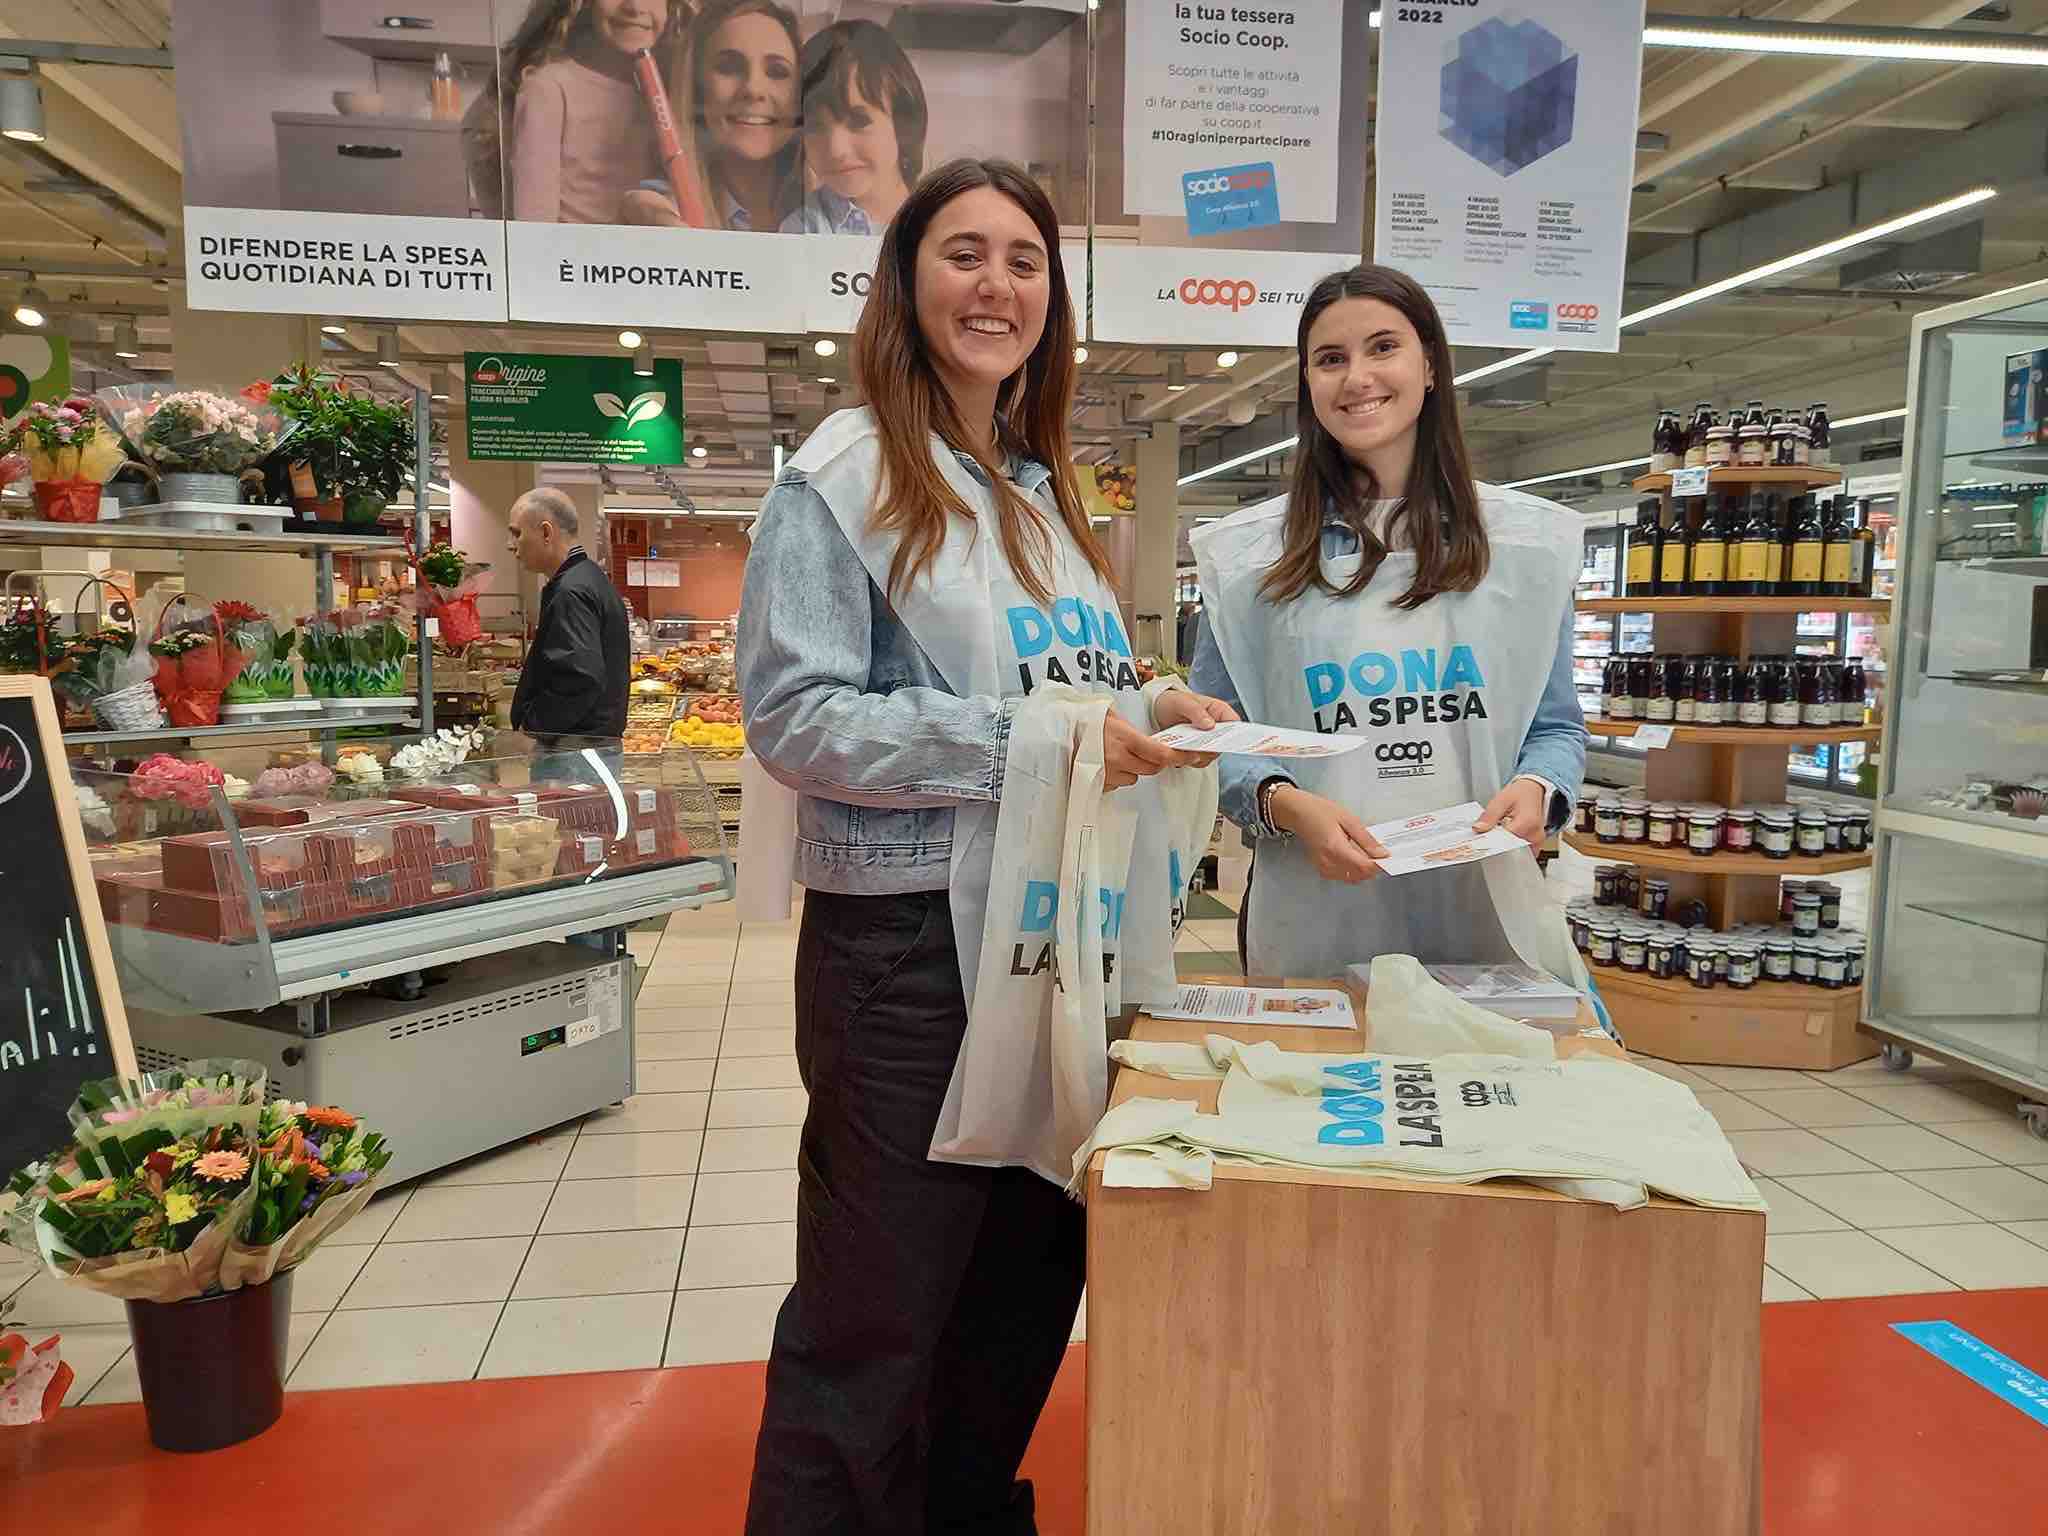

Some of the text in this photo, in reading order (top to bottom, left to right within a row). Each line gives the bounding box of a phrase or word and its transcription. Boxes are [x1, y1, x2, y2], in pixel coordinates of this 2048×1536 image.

[1175, 3, 1295, 25] la tua tessera
[1398, 8, 1443, 24] 2022
[1180, 27, 1289, 51] Socio Coop.
[1168, 65, 1208, 79] Scopri
[1211, 67, 1240, 80] tutte
[199, 236, 488, 267] DIFENDERE LA SPESA
[200, 261, 492, 291] QUOTIDIANA DI TUTTI
[560, 259, 750, 291] È IMPORTANTE.
[1158, 289, 1176, 301] LA
[1179, 278, 1257, 313] coop
[1258, 292, 1282, 304] SEI
[1304, 645, 1486, 709] DONA
[1313, 691, 1488, 735] LA SPESA
[1374, 740, 1433, 764] coop
[1396, 1114, 1444, 1148] LA
